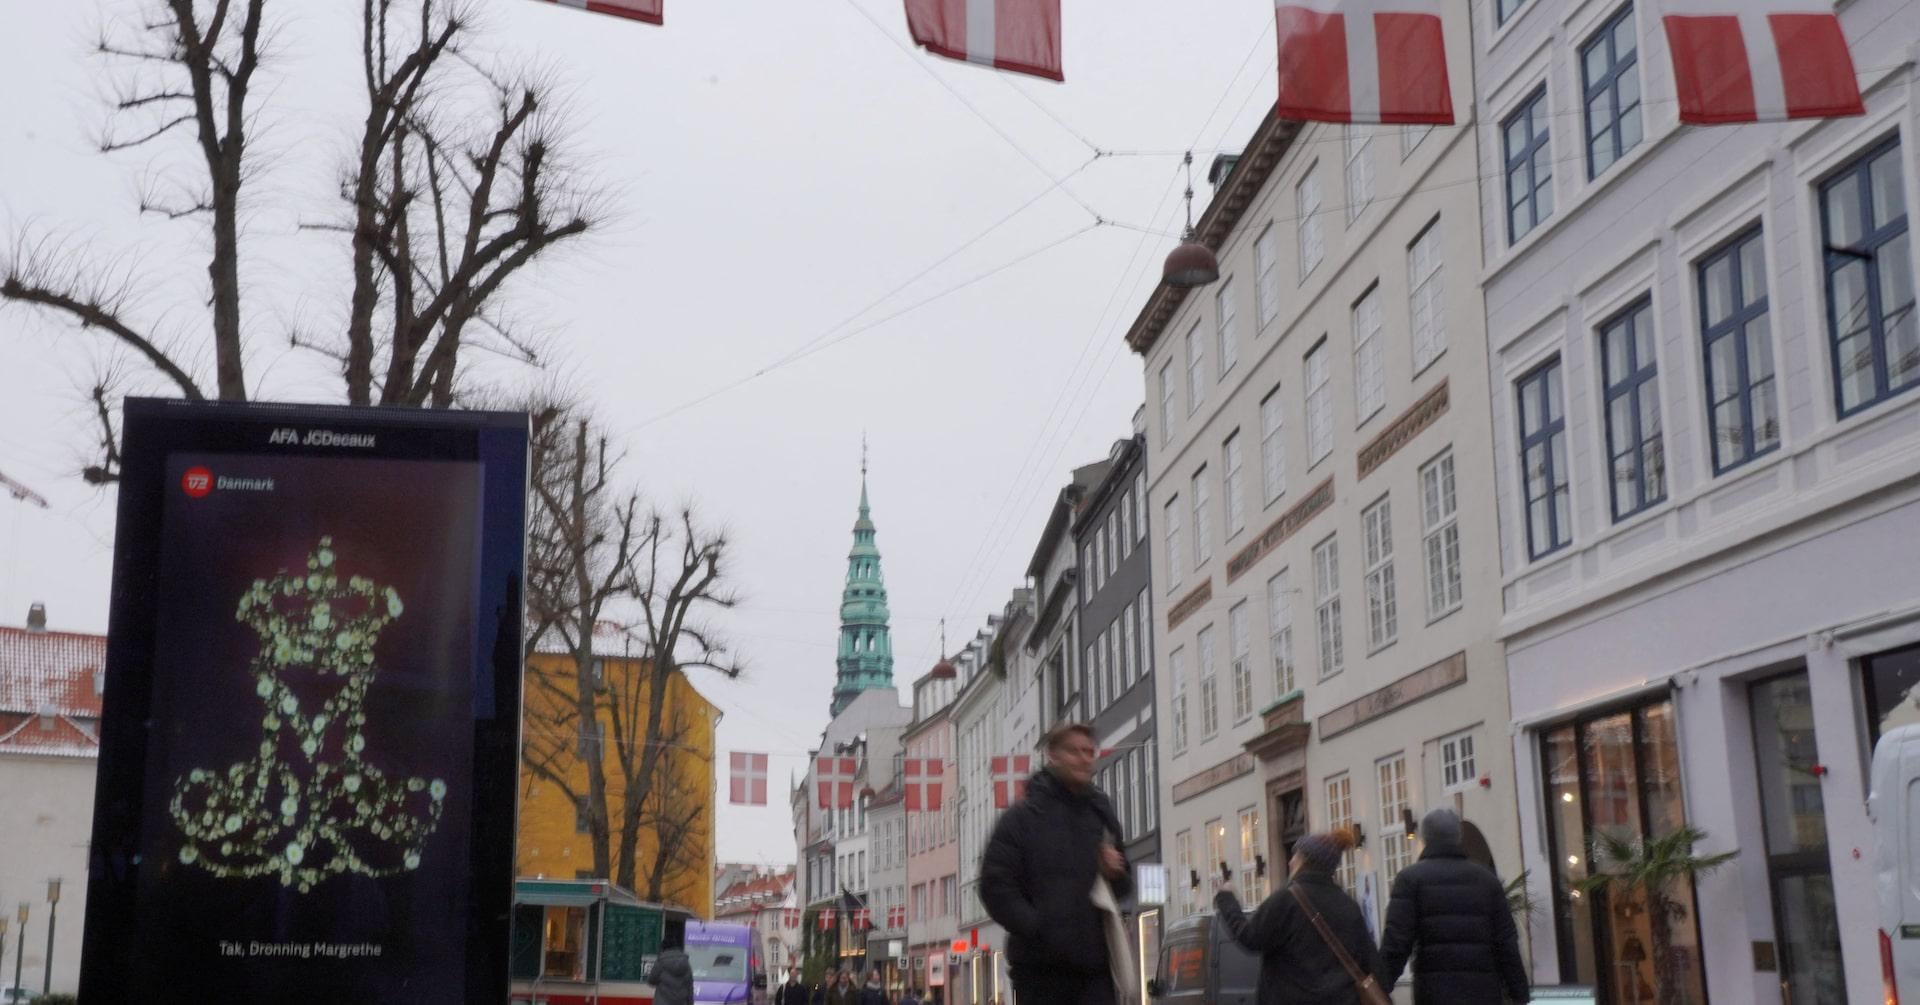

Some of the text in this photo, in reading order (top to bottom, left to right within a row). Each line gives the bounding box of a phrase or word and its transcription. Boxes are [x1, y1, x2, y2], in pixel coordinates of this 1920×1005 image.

[269, 427, 376, 448] AFA JCDecaux
[216, 474, 275, 492] Danmark
[219, 939, 382, 959] Tak, Dronning Margrethe
